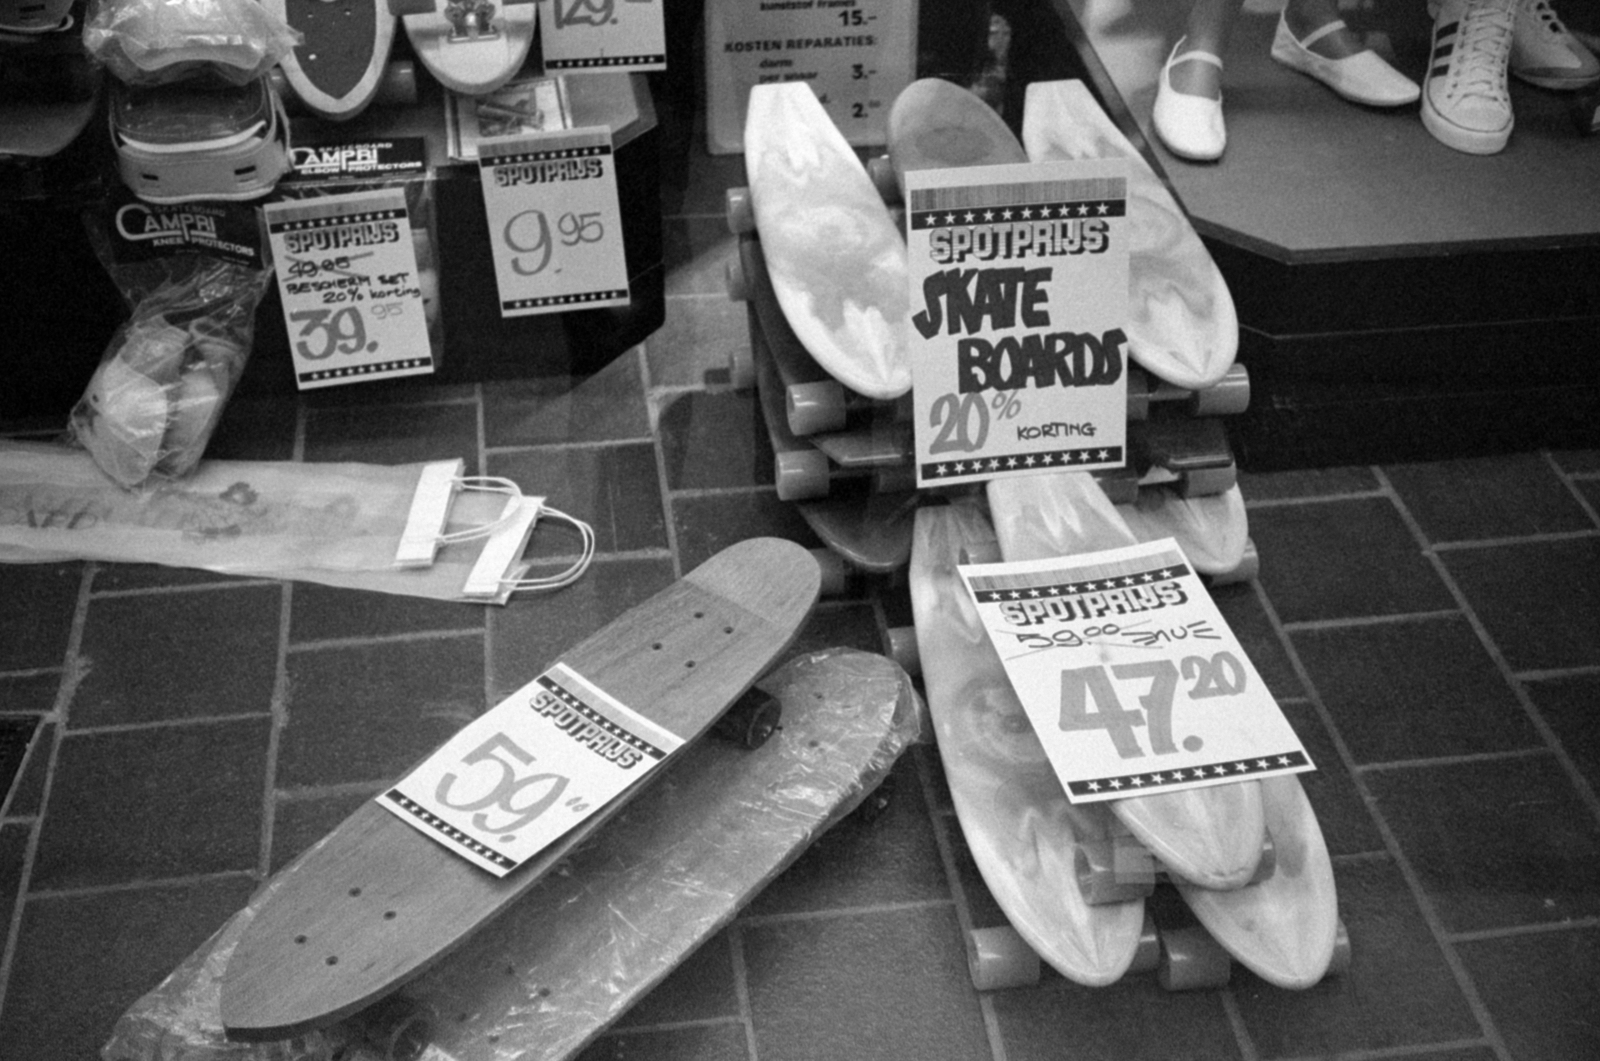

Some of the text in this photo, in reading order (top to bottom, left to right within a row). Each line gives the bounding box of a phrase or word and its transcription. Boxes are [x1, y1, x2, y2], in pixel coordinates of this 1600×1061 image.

[724, 40, 782, 52] KOSTEN
[290, 147, 378, 170] CAMPRI
[319, 142, 393, 152] SKATEBOARD
[301, 161, 422, 175] ELBOW PROTECTORS
[493, 158, 604, 187] SPOTPRIJS
[115, 203, 217, 241] CAMPRI
[153, 237, 185, 247] KNEE
[191, 237, 254, 256] PROTECTORS
[284, 222, 400, 253] SPOTPRIJS
[929, 216, 1110, 265] SPOTPRIJS
[323, 286, 364, 304] 20%
[911, 266, 1053, 340] SKATE
[957, 327, 1128, 394] BOARDS
[1016, 422, 1097, 441] KORTING
[999, 579, 1190, 627] SPOTPRIJS
[529, 690, 644, 770] SPOTPRIJS
